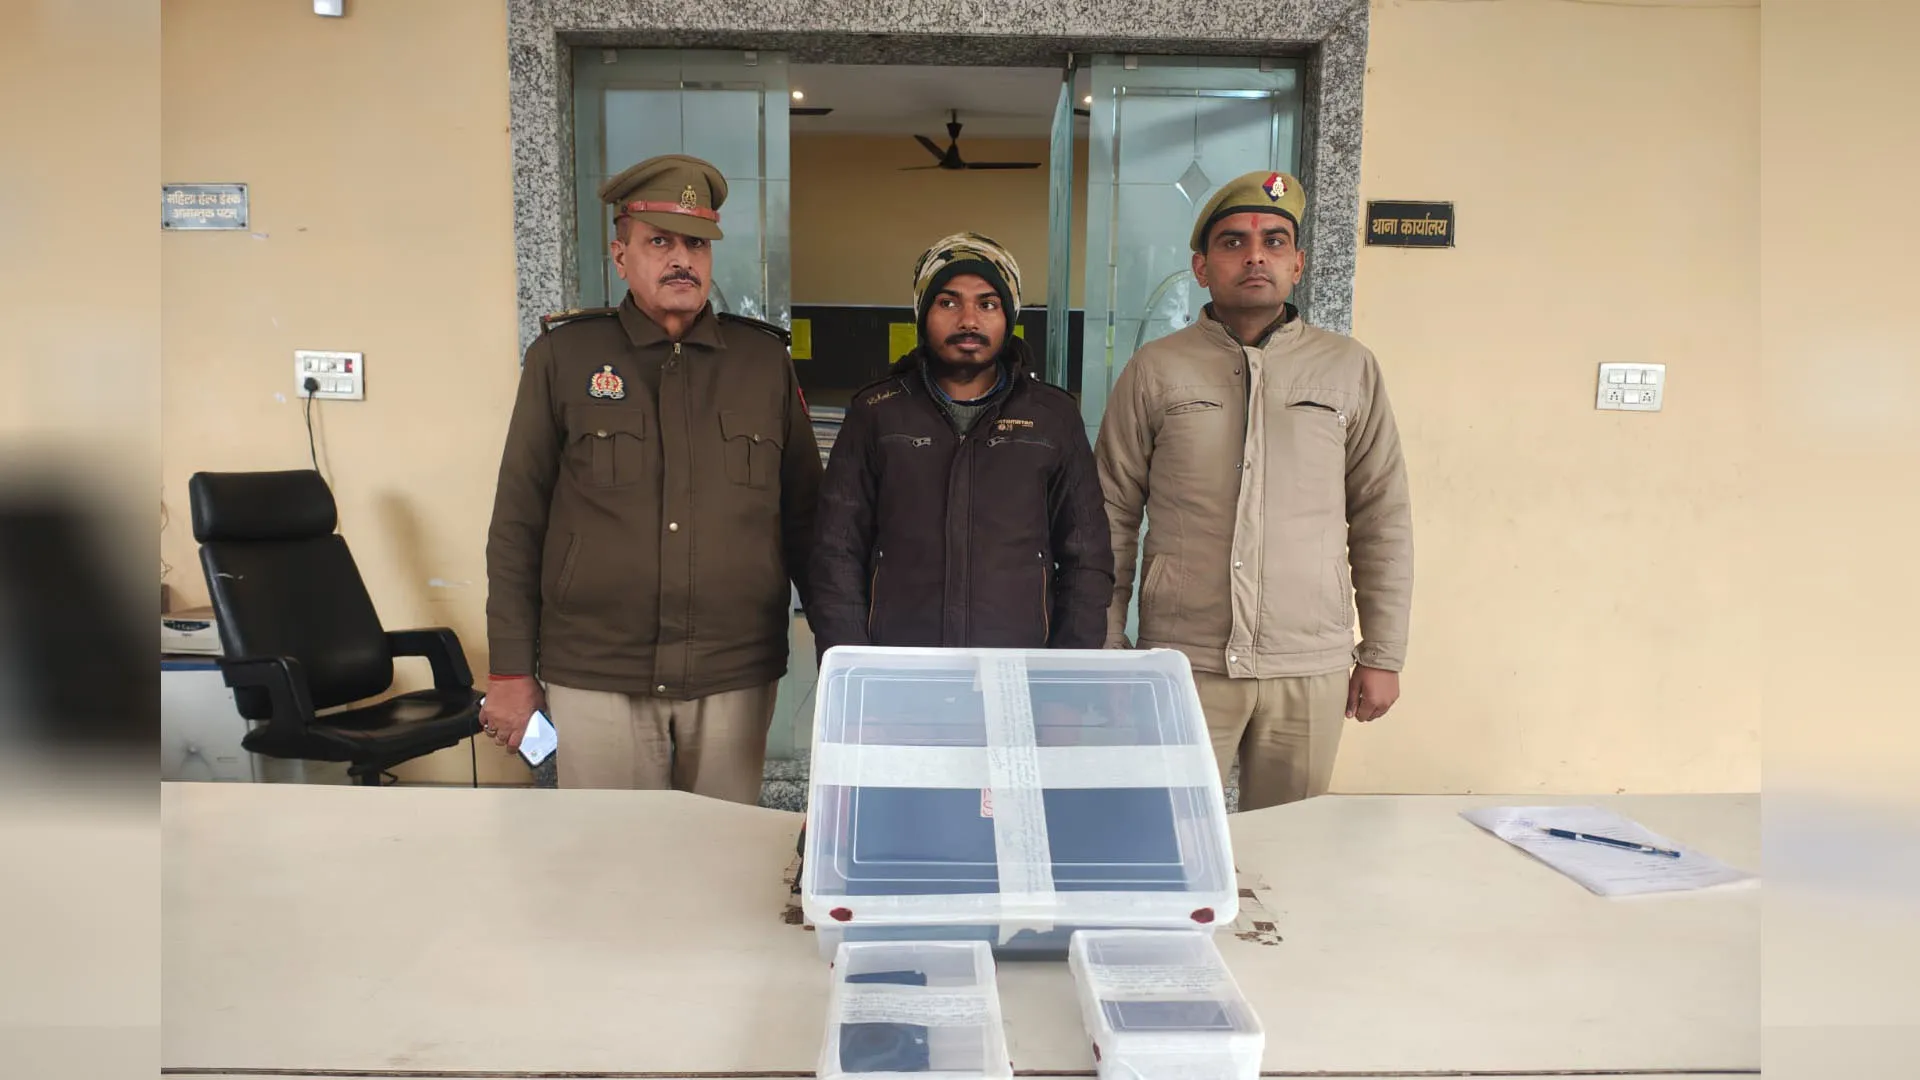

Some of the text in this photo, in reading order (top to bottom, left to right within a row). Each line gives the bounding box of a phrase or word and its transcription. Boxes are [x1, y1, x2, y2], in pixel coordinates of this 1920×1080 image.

[167, 191, 196, 205] महिला
[1372, 212, 1448, 236] थाना कार्यालय
